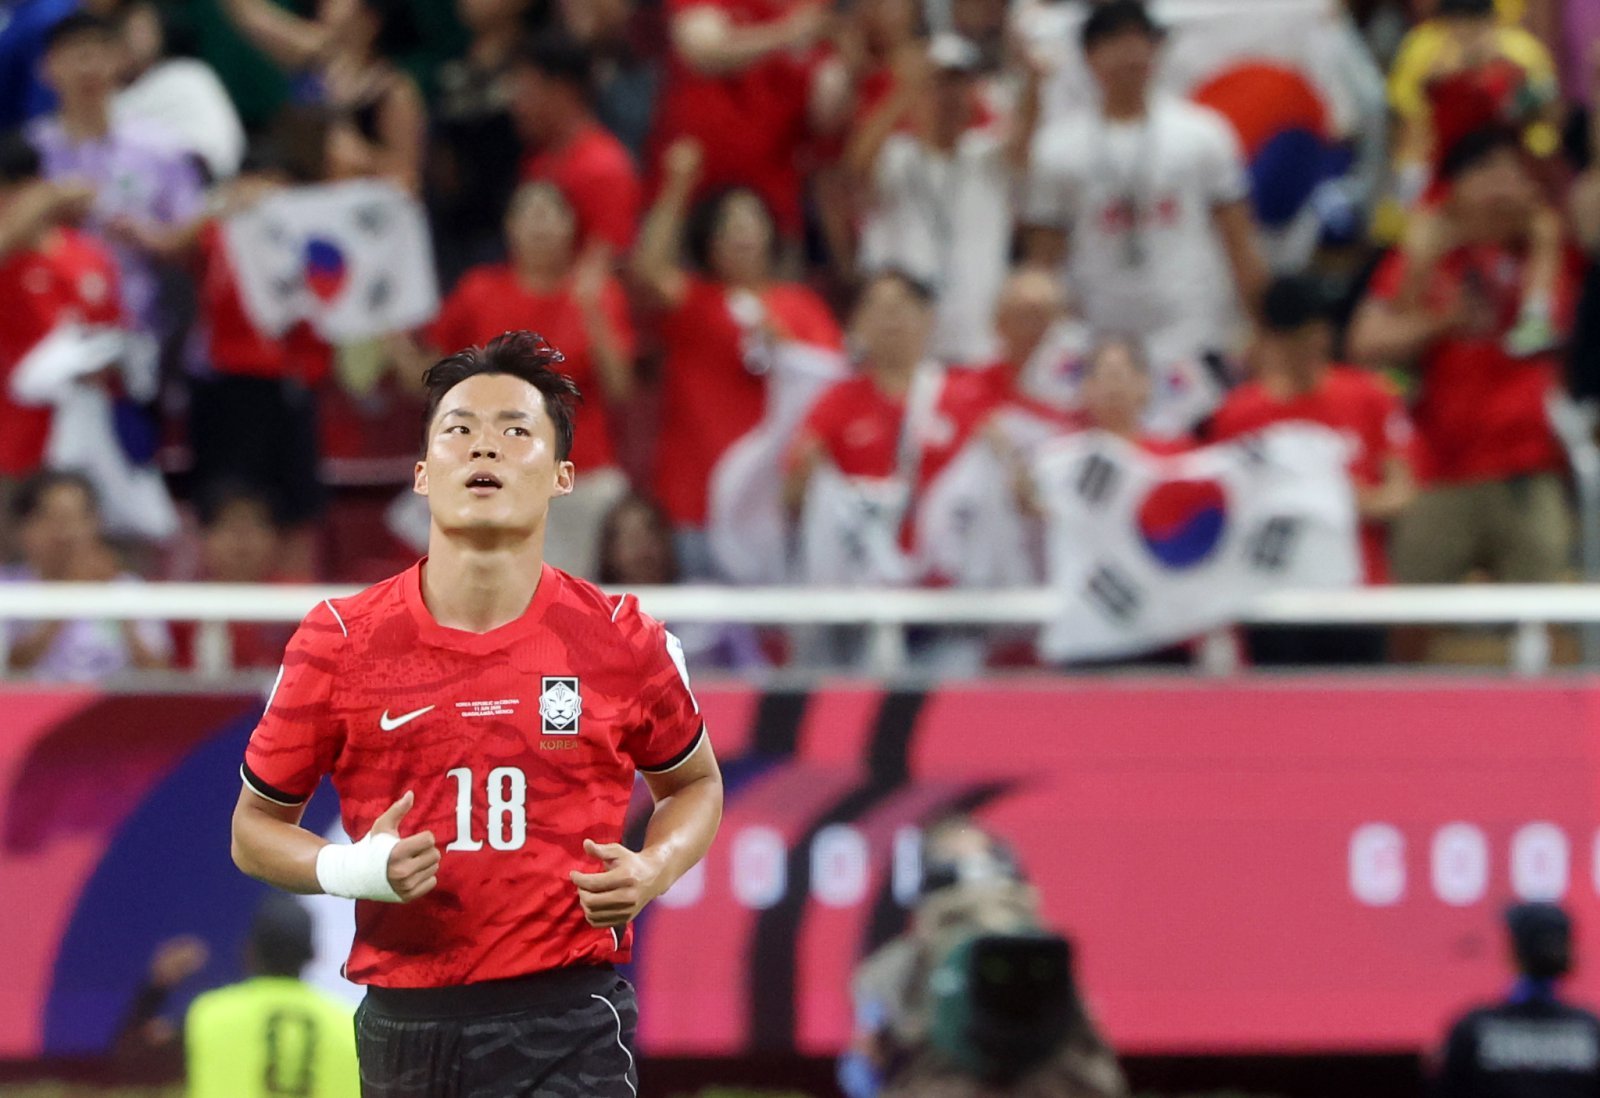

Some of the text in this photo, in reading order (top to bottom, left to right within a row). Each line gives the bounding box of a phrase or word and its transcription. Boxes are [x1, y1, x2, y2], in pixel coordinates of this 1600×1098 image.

[539, 739, 578, 751] KOREA
[446, 766, 527, 854] 18
[1347, 819, 1600, 907] GOO
